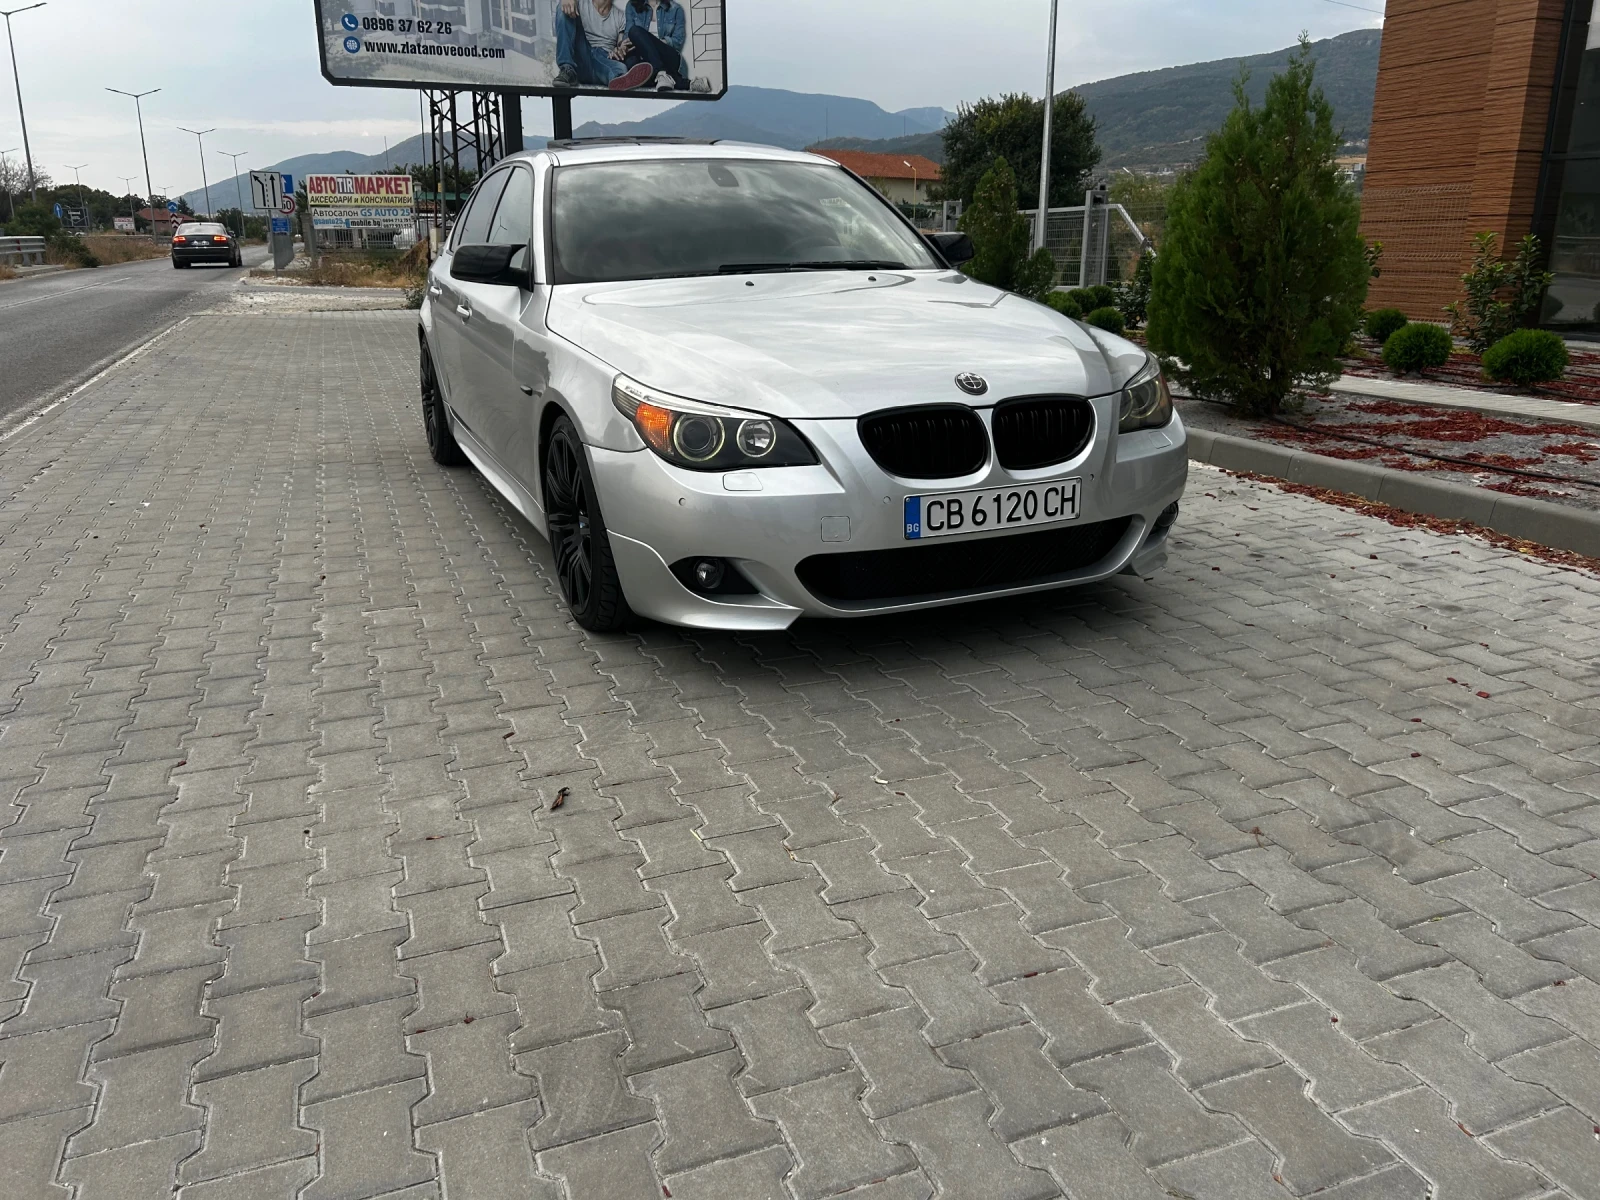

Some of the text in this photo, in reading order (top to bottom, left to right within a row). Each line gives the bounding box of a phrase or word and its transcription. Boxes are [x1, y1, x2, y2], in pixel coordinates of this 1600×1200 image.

[362, 17, 452, 35] 0896 37 62 26
[364, 41, 506, 59] www.zlatanoveood.com
[310, 195, 353, 204] АКСЕСОАРИ
[360, 195, 413, 204] КОНСУМАТИВИ
[313, 208, 411, 217] Автосалон GS AUTO 25
[906, 523, 920, 533] BG
